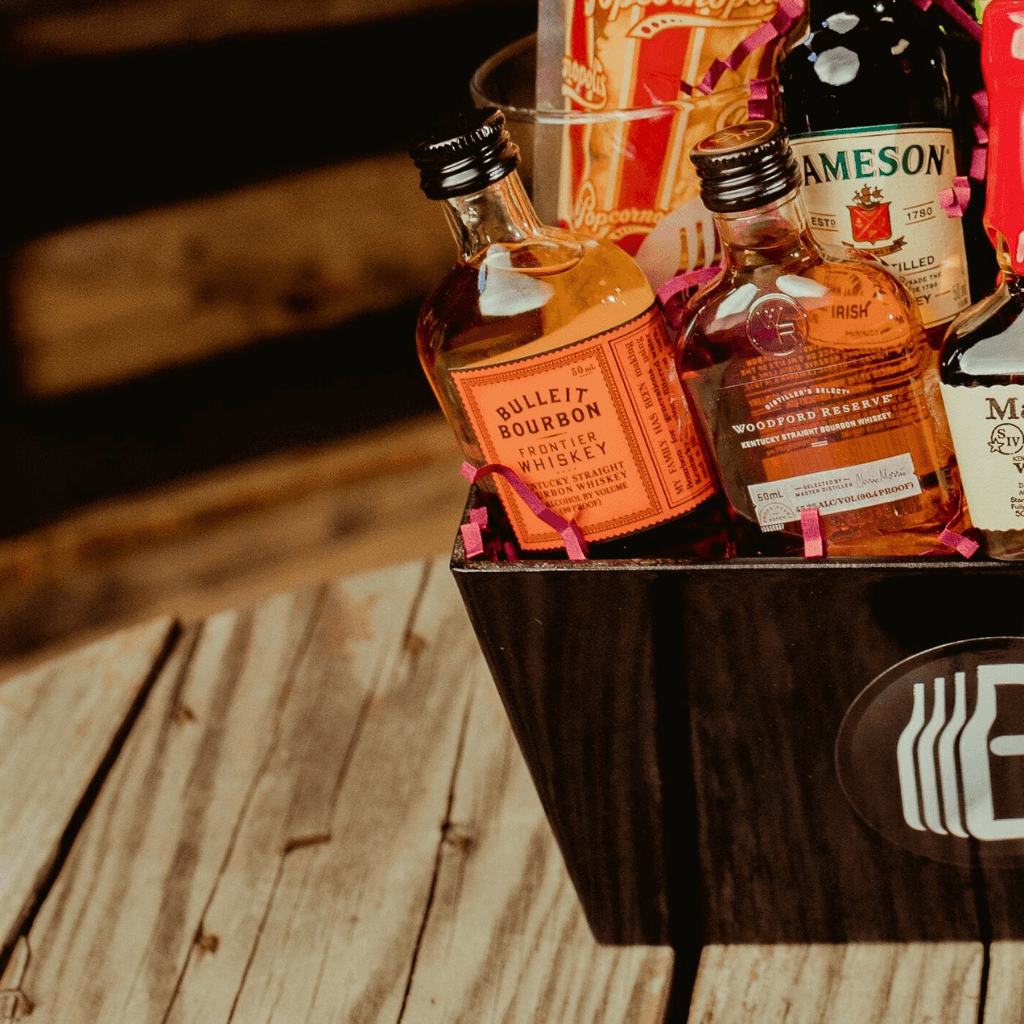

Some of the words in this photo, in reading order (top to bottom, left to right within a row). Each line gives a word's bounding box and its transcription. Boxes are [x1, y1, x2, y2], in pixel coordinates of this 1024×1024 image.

[803, 144, 945, 186] AMESON
[811, 217, 836, 226] ESTD
[907, 207, 933, 220] 1780
[831, 303, 868, 320] IRISH
[571, 365, 583, 376] 50
[625, 341, 642, 377] making
[496, 387, 588, 421] BULLEIT
[638, 382, 654, 409] BEEN
[765, 388, 812, 411] DISTILLER'S
[815, 387, 848, 395] SELECT
[498, 401, 601, 439] BOURBON
[650, 413, 663, 434] HAS
[732, 410, 816, 434] WOODFORD
[820, 394, 891, 417] RESERVE
[741, 435, 780, 449] KENTUCKY
[781, 427, 819, 441] STRAIGHT
[820, 420, 856, 434] BOURBON
[857, 411, 892, 427] WHISKEY
[518, 441, 606, 474] WHISKEY
[519, 432, 597, 458] FRONTIER
[658, 440, 677, 475] FAMILY
[530, 476, 568, 491] NTUCKY
[572, 460, 625, 483] STRAIGHT
[536, 486, 573, 500] URBON
[576, 470, 627, 491] WHISKEY
[672, 479, 684, 495] MY
[803, 479, 834, 490] SELECTED
[546, 495, 582, 508] ALCOHOL
[582, 492, 593, 500] BY
[594, 482, 629, 497] VOLUME
[757, 490, 783, 502] 50mL
[795, 489, 820, 498] MASTER
[821, 482, 853, 494] DISTILLER
[878, 482, 914, 496] PROOF)
